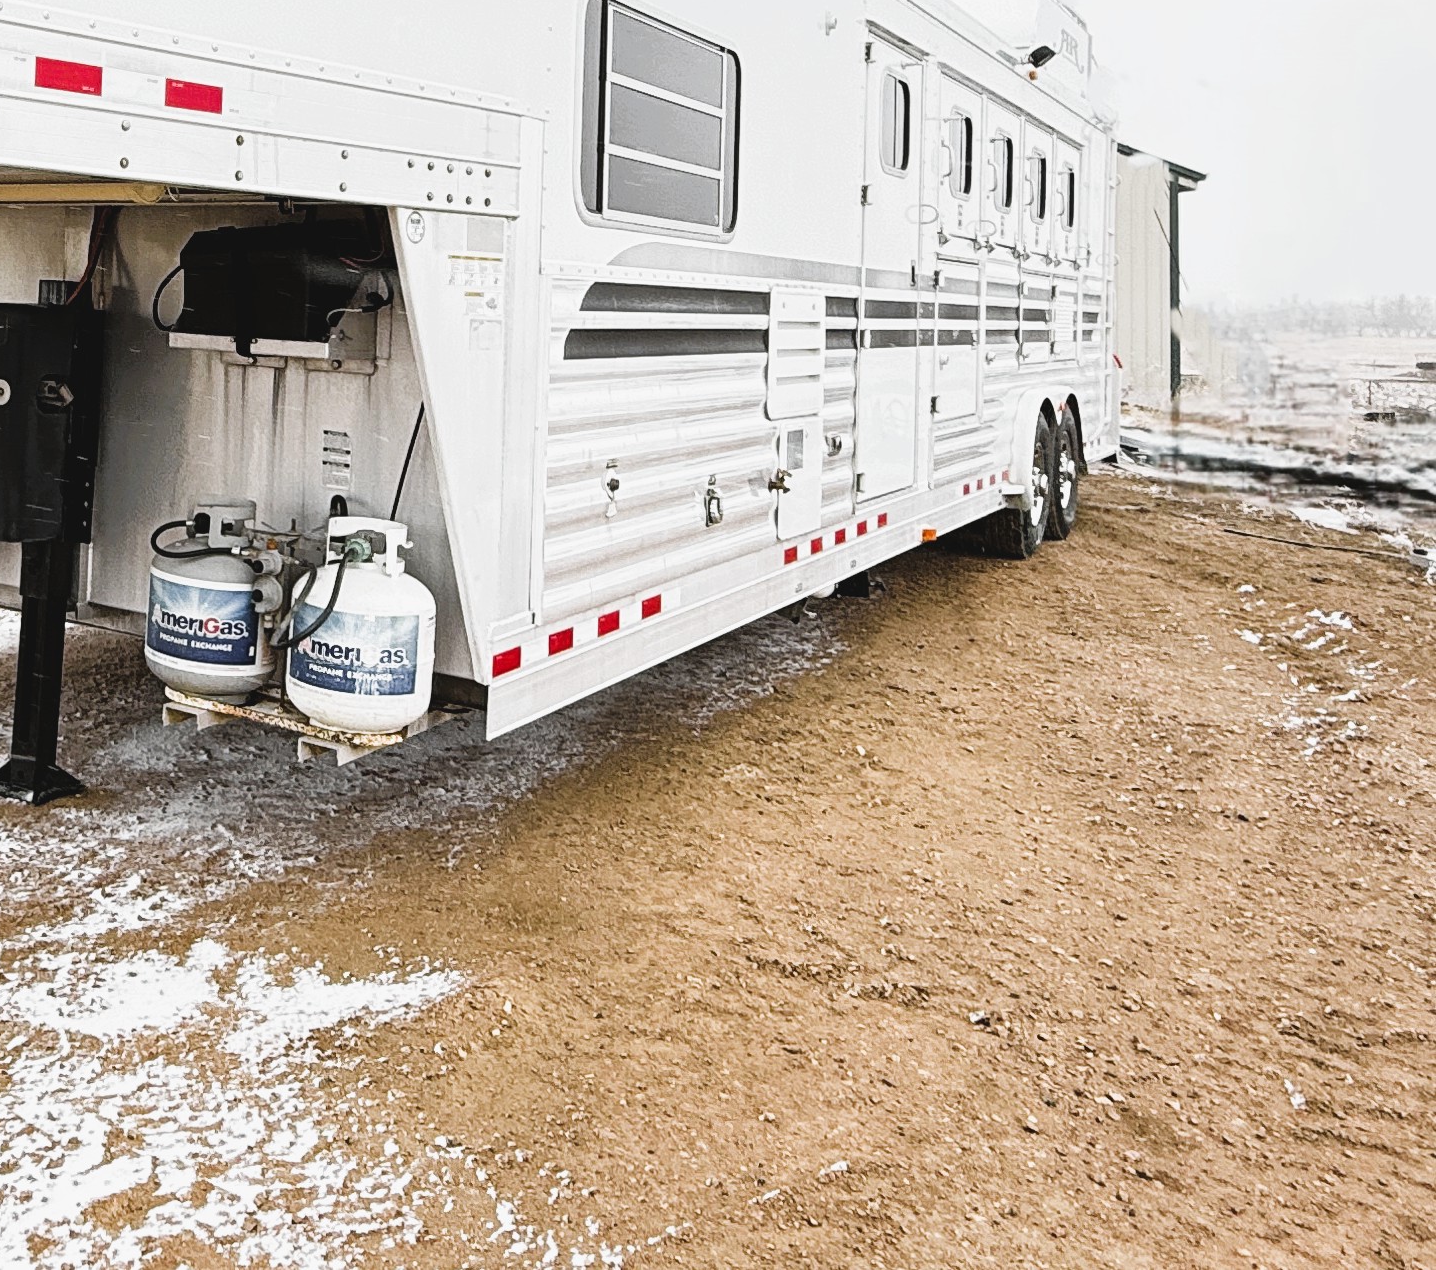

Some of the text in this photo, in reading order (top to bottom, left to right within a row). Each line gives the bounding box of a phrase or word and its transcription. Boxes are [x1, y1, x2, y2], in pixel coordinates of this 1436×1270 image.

[152, 604, 246, 637] AmeriGas
[159, 632, 232, 652] PROPANE EXCHANGE
[299, 636, 405, 664] Amerias
